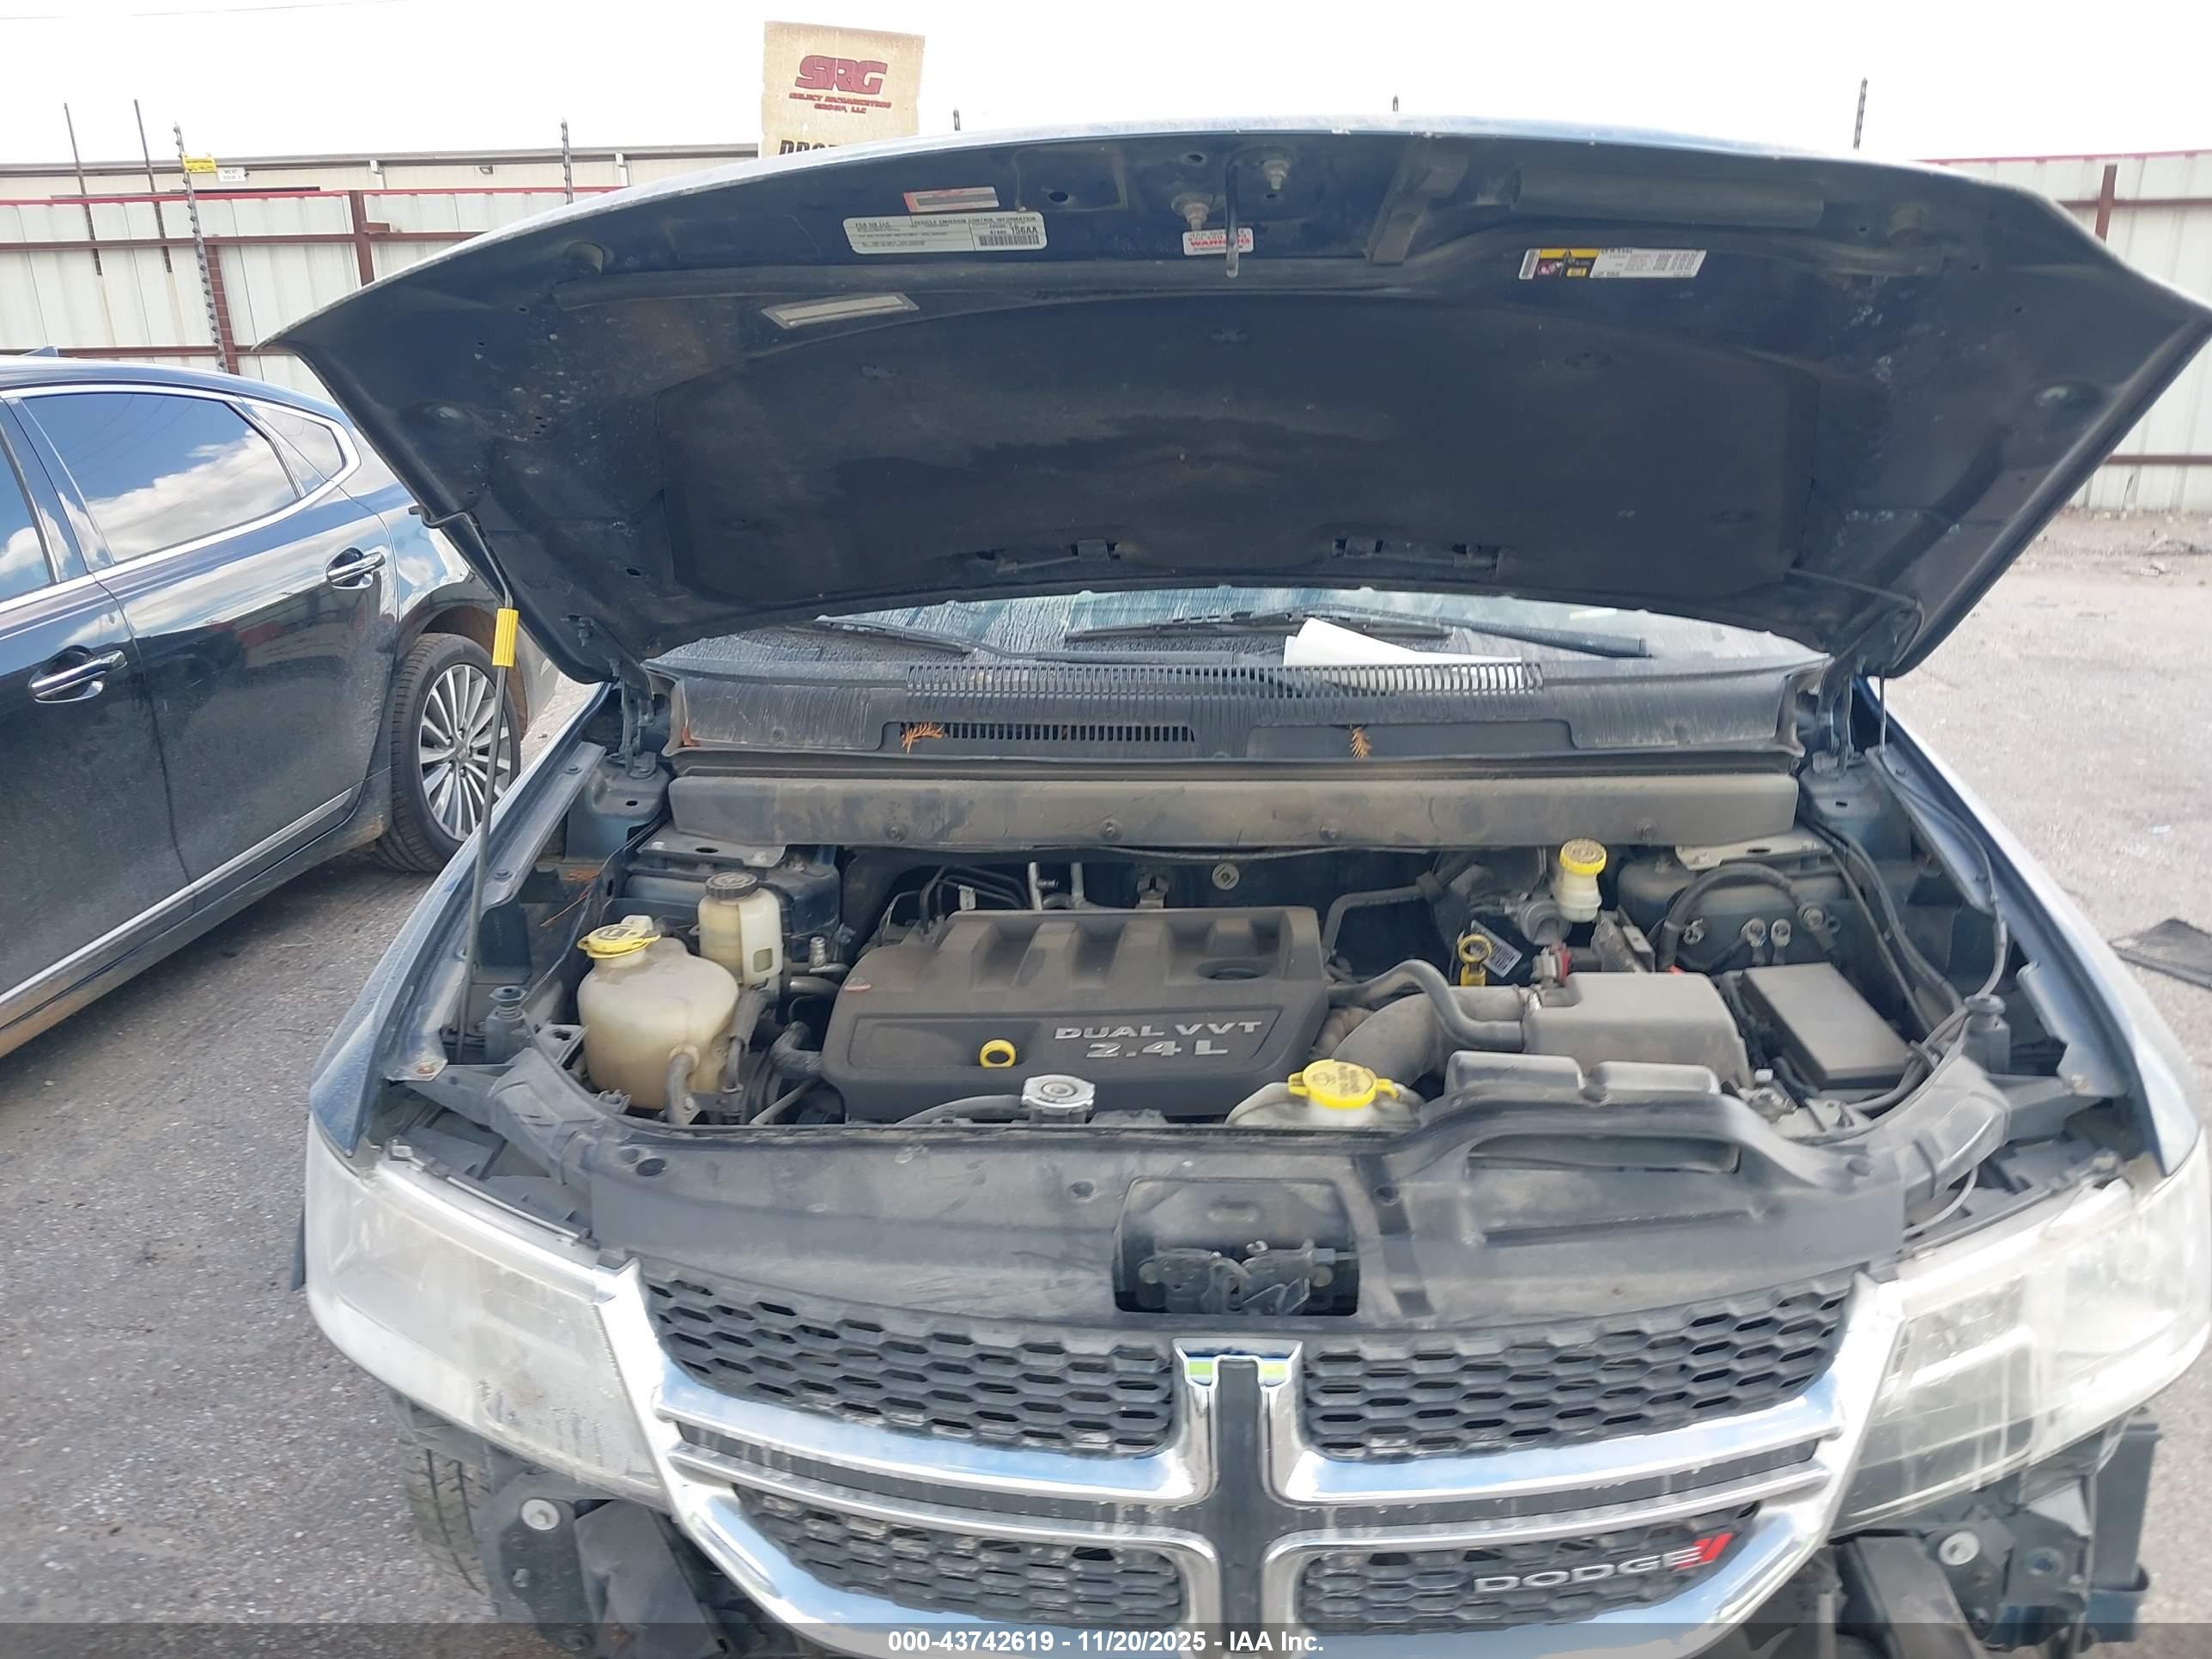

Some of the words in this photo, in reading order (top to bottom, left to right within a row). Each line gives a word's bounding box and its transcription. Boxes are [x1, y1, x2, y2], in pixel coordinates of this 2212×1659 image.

[795, 55, 888, 94] SRG
[1054, 1024, 1165, 1040] DUAL
[1175, 1020, 1262, 1036] VVT
[1474, 1545, 1703, 1593] DODGE
